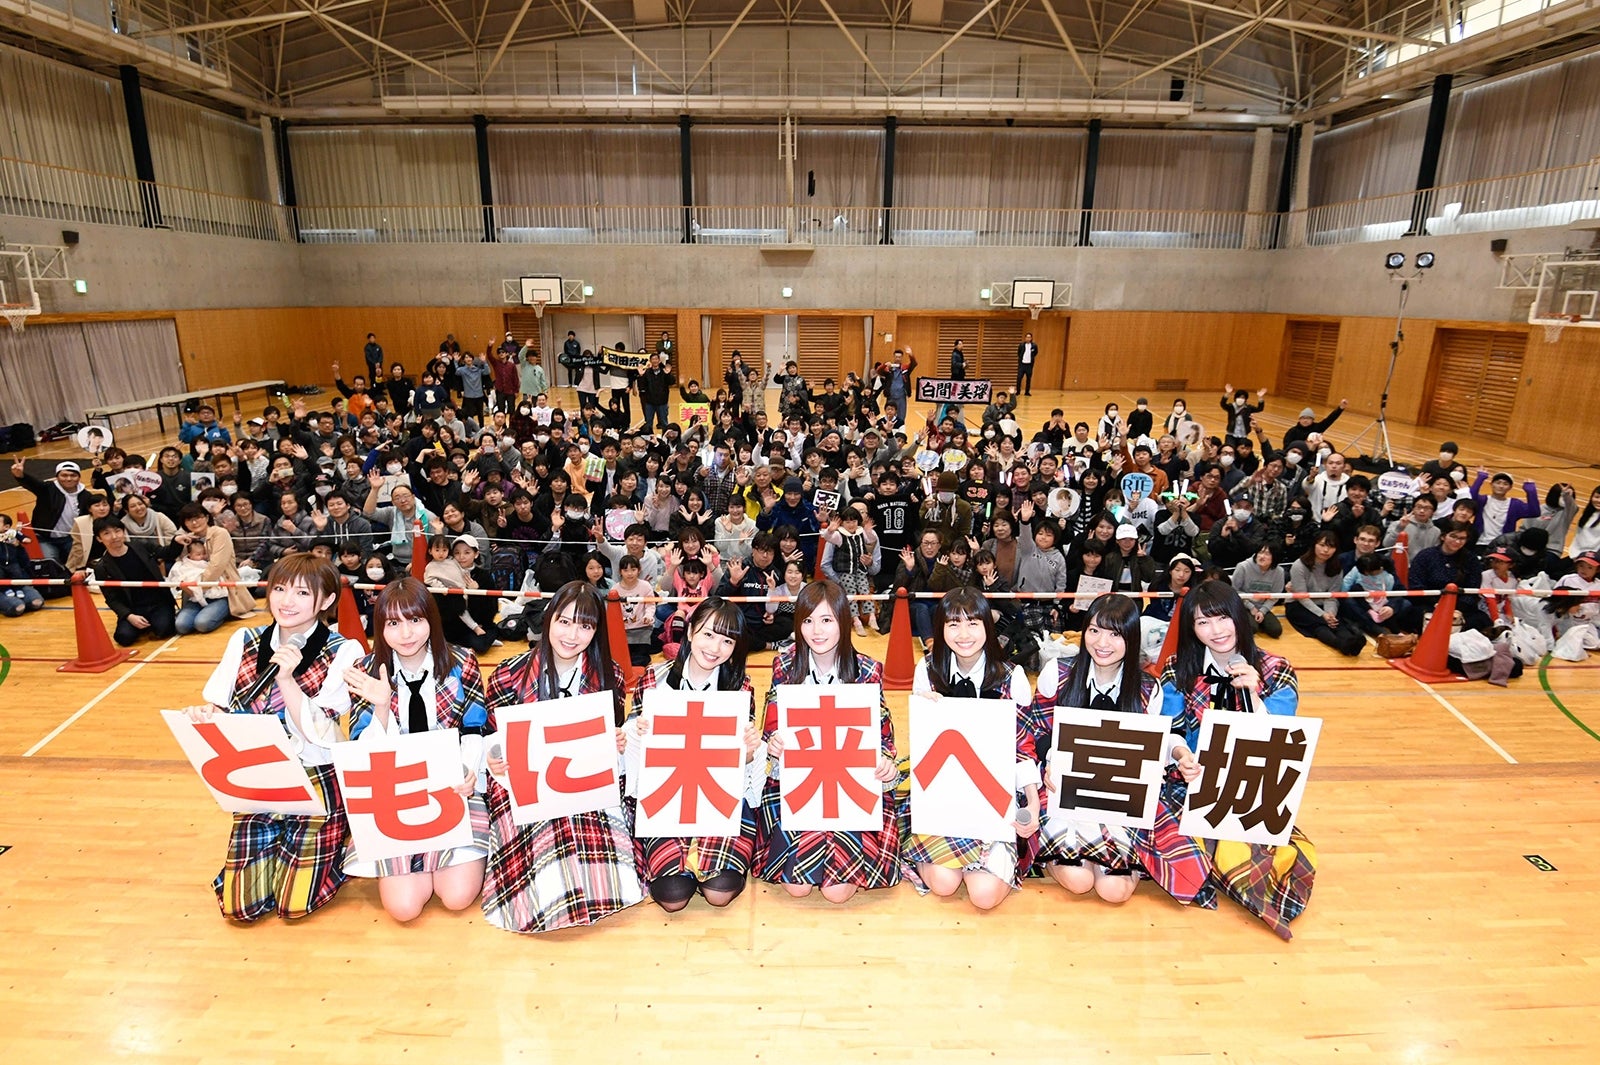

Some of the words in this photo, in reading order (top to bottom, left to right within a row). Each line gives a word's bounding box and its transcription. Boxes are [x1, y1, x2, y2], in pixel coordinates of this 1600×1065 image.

[818, 493, 837, 505] こみ
[884, 508, 904, 529] 18
[967, 486, 988, 499] こみ
[1123, 479, 1151, 493] RIE
[193, 722, 313, 803] と
[344, 752, 466, 842] も
[506, 716, 615, 807] に
[641, 702, 741, 825] 未
[784, 696, 879, 819] 来
[914, 730, 1013, 818] へ
[1057, 720, 1164, 819] 宮
[1188, 723, 1307, 836] 城
